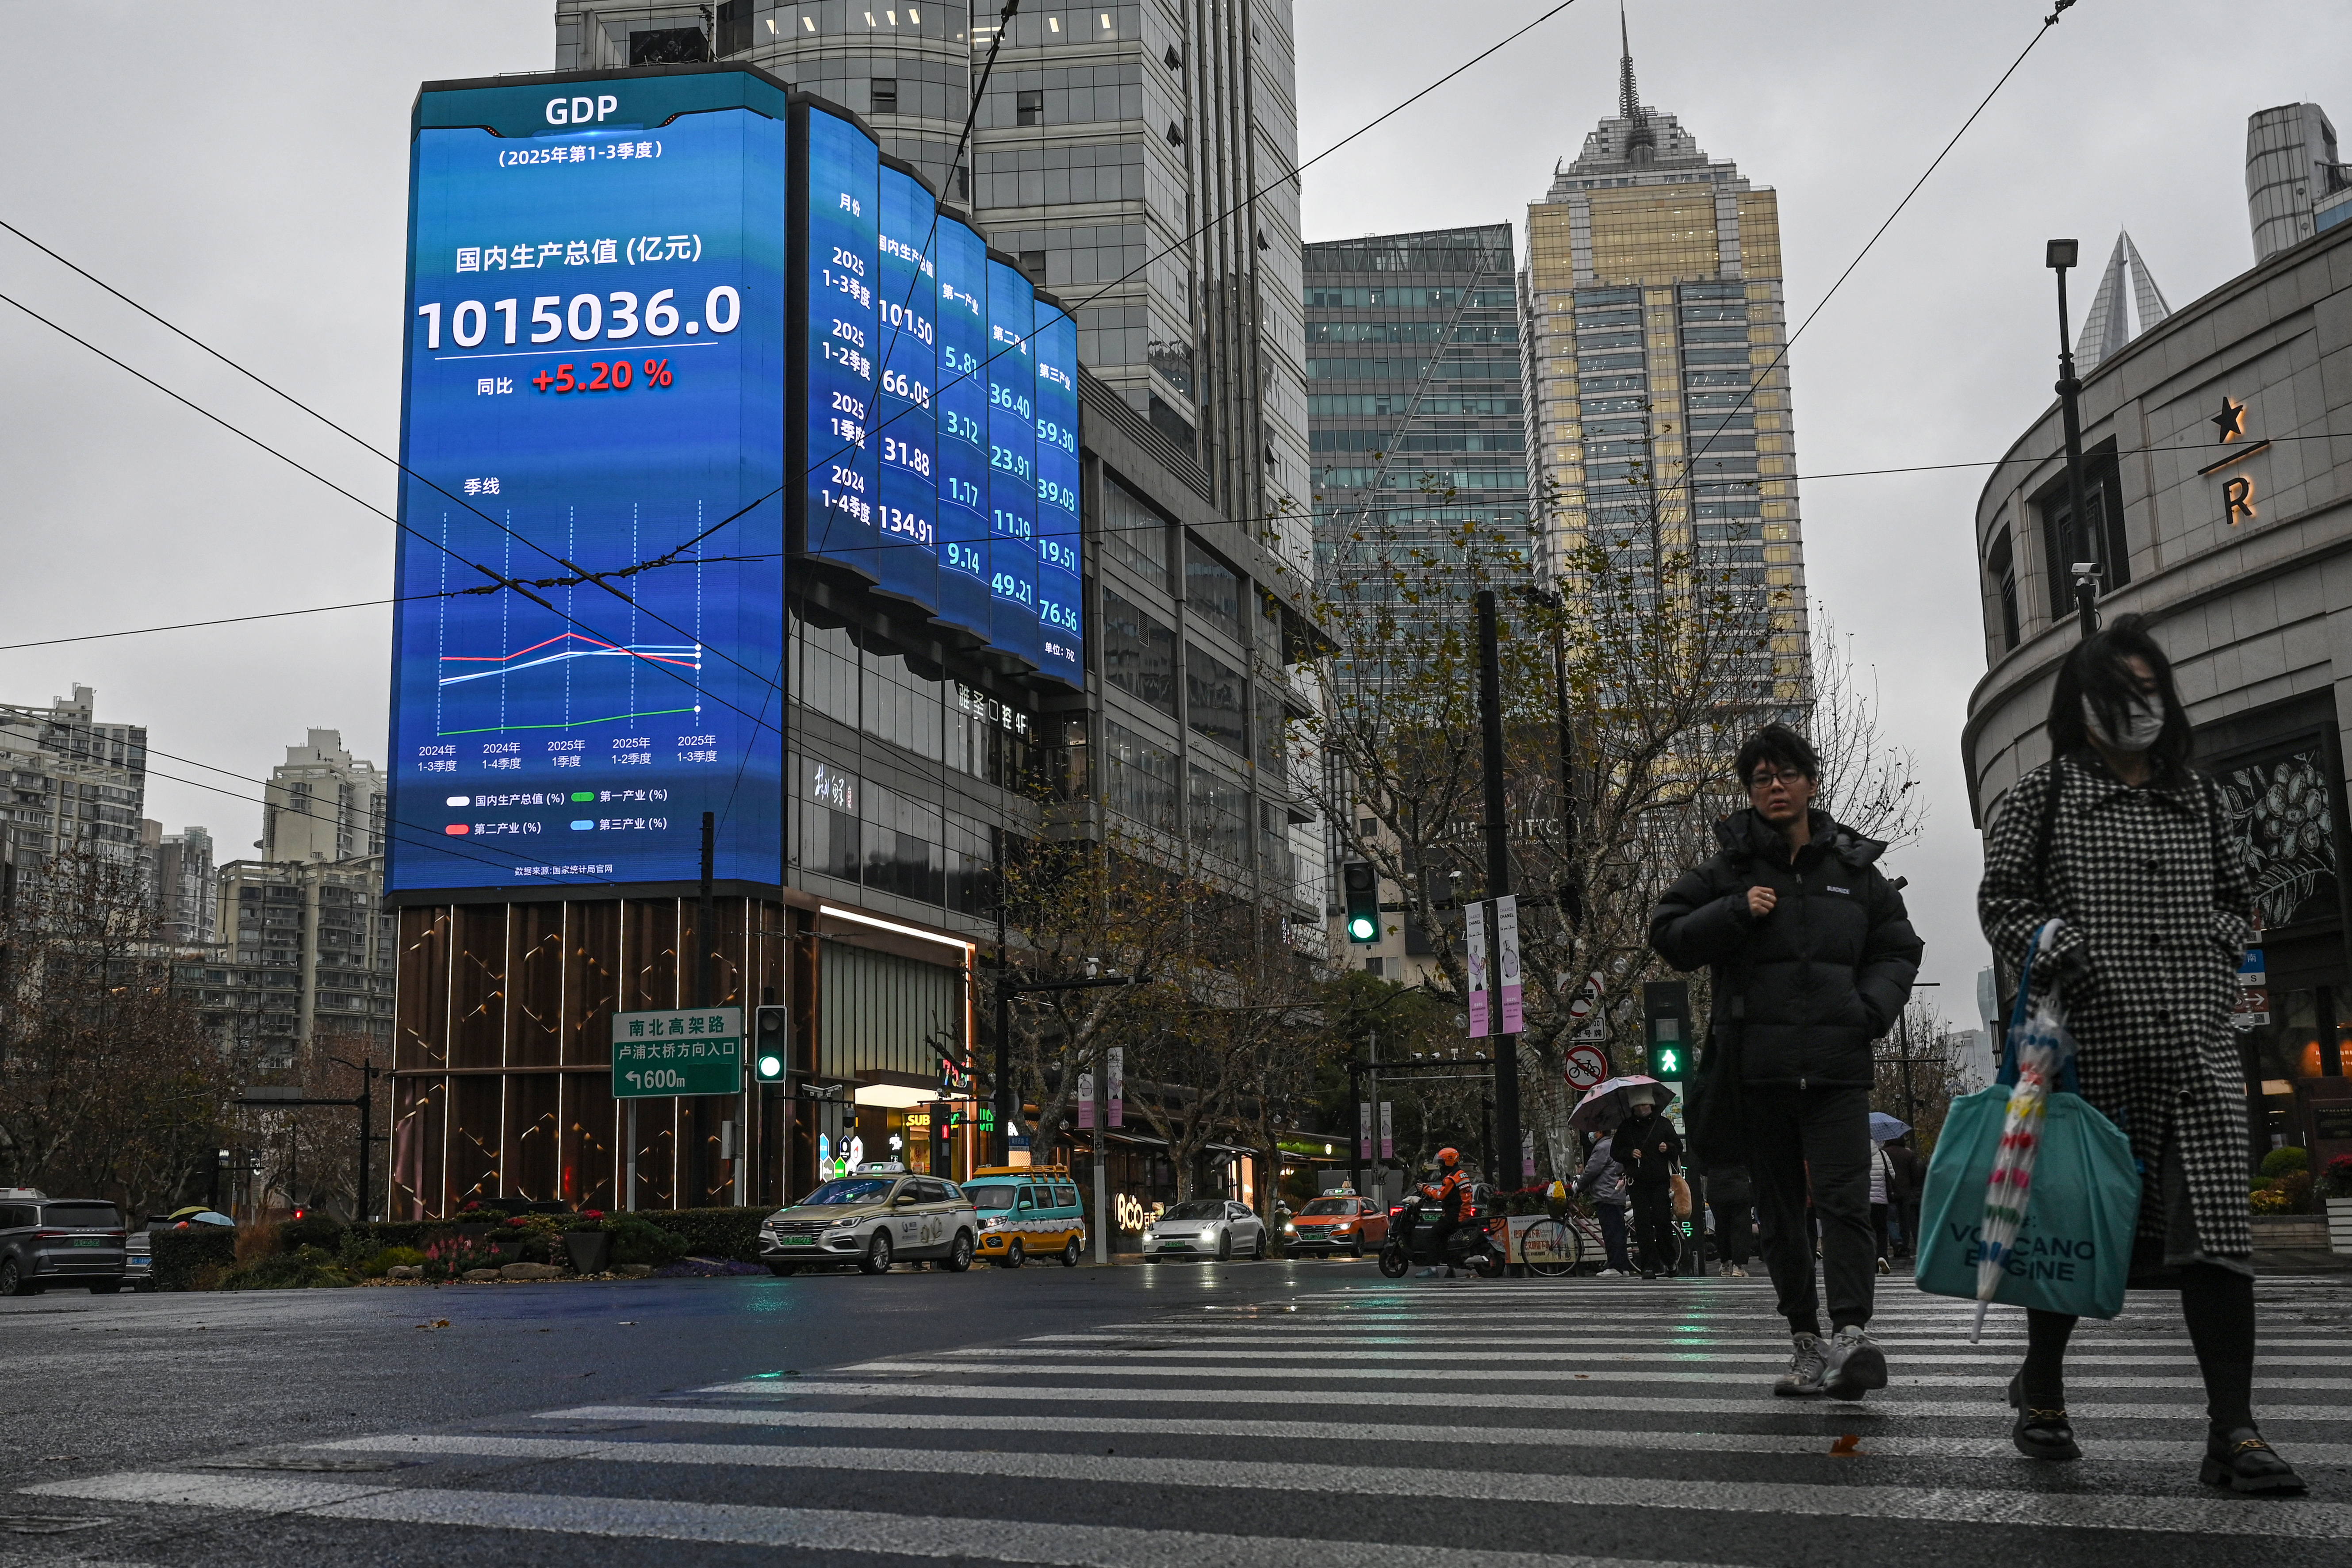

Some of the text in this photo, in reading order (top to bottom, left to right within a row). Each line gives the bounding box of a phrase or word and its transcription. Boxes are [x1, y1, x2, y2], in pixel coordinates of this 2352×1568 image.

[546, 95, 617, 125] GDP
[839, 192, 860, 218] 月份
[456, 234, 701, 273] 国内生产总值 (亿元)
[832, 246, 864, 277] 2025
[879, 234, 933, 279] 国内生产总值
[823, 269, 870, 310] 1-3季度
[942, 283, 978, 316] 第一产业
[418, 285, 740, 349] 1015036.0
[879, 299, 932, 345] 101.50
[832, 318, 864, 349] 2025
[993, 324, 1027, 355] 第二产业
[823, 341, 870, 381] 1-2季度
[945, 345, 978, 380] 5.81
[1039, 362, 1071, 391] 第三产业
[478, 376, 513, 396] 同比
[533, 360, 632, 392] +5.20
[883, 370, 929, 409] 66.05
[832, 391, 864, 420] 2025
[990, 383, 1030, 420] 36.40
[831, 418, 865, 450] 1季度
[947, 411, 978, 445] 3.12
[1036, 418, 1073, 453] 59.30
[884, 437, 930, 476] 31.88
[991, 445, 1029, 481] 23.91
[464, 477, 500, 496] 季线
[832, 465, 864, 493] 2024
[949, 477, 978, 507] 1.17
[822, 490, 870, 526] 1-4季度
[1038, 478, 1074, 512] 39.03
[2222, 477, 2252, 525] R
[879, 506, 932, 547] 134.91
[994, 510, 1030, 541] 11.19
[947, 543, 979, 574] 9.14
[1039, 539, 1074, 571] 19.51
[991, 572, 1031, 605] 49.21
[1039, 599, 1077, 631] 76.56
[419, 744, 456, 756] 2024年
[483, 742, 521, 754] 2024年
[548, 739, 586, 751] 2025年
[613, 736, 651, 749] 2025年
[678, 734, 716, 747] 2025年
[418, 759, 457, 772] 1-3季度
[482, 757, 521, 770] 1-4季度
[552, 755, 581, 767] 1季度
[612, 752, 651, 765] 1-2季度
[677, 750, 717, 763] 1-3季度
[475, 793, 544, 807] 国内生产总值
[600, 789, 646, 802] 第一产业
[474, 822, 520, 835] 第二产业
[599, 817, 645, 831] 第三产业
[2247, 954, 2256, 962] 南
[629, 1015, 724, 1037] 南北高架路
[618, 1042, 735, 1060] 卢浦大桥方向入口
[644, 1069, 685, 1089] 600m
[1950, 1223, 2095, 1260] VOCANO
[1964, 1248, 2075, 1281] EGINE
